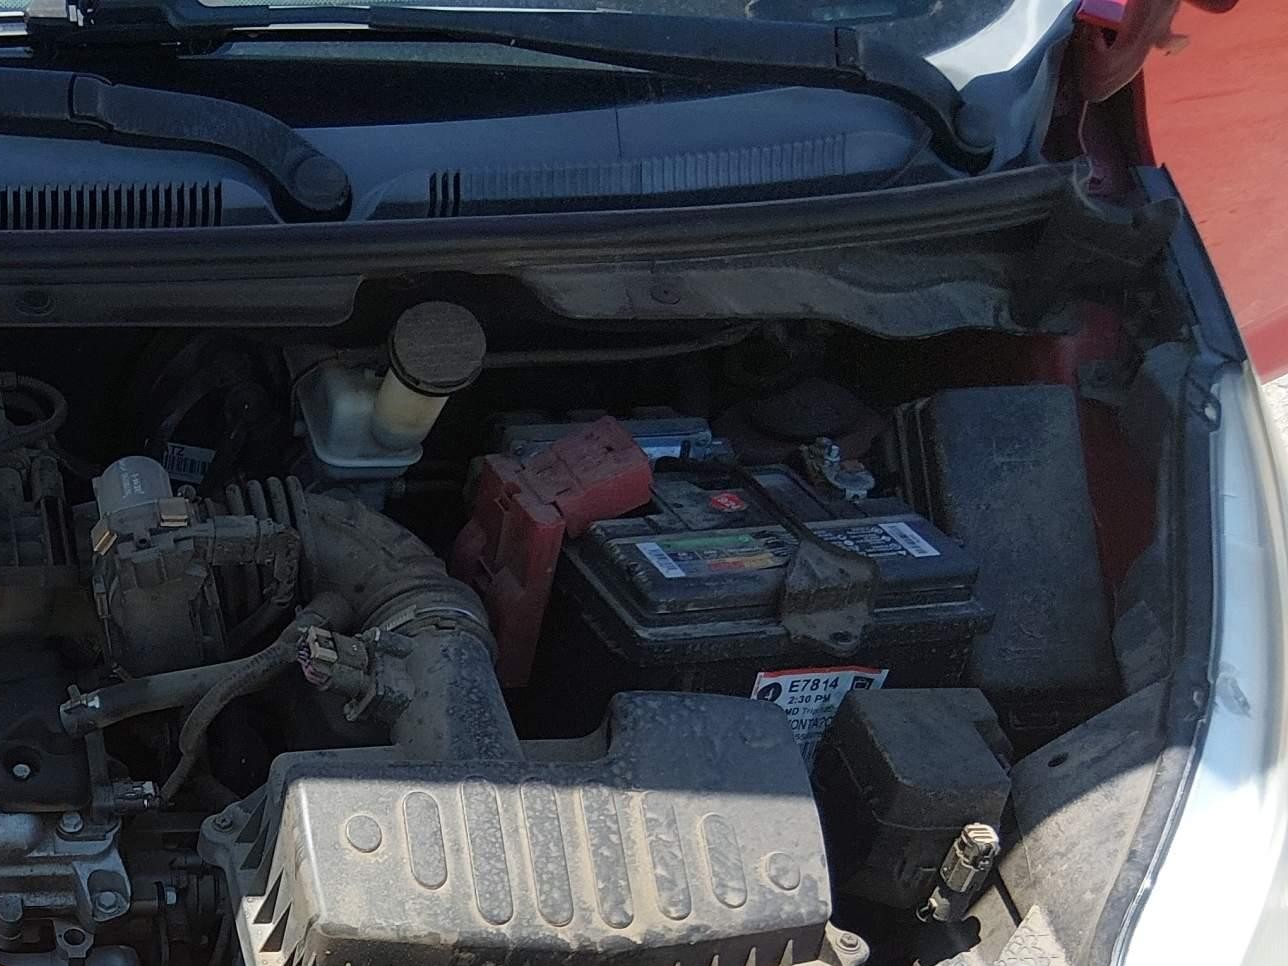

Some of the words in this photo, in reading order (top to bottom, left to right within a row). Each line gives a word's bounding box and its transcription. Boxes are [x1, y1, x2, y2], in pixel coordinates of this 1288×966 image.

[788, 676, 840, 693] E7814
[787, 695, 812, 705] 2:30
[814, 694, 831, 703] PM
